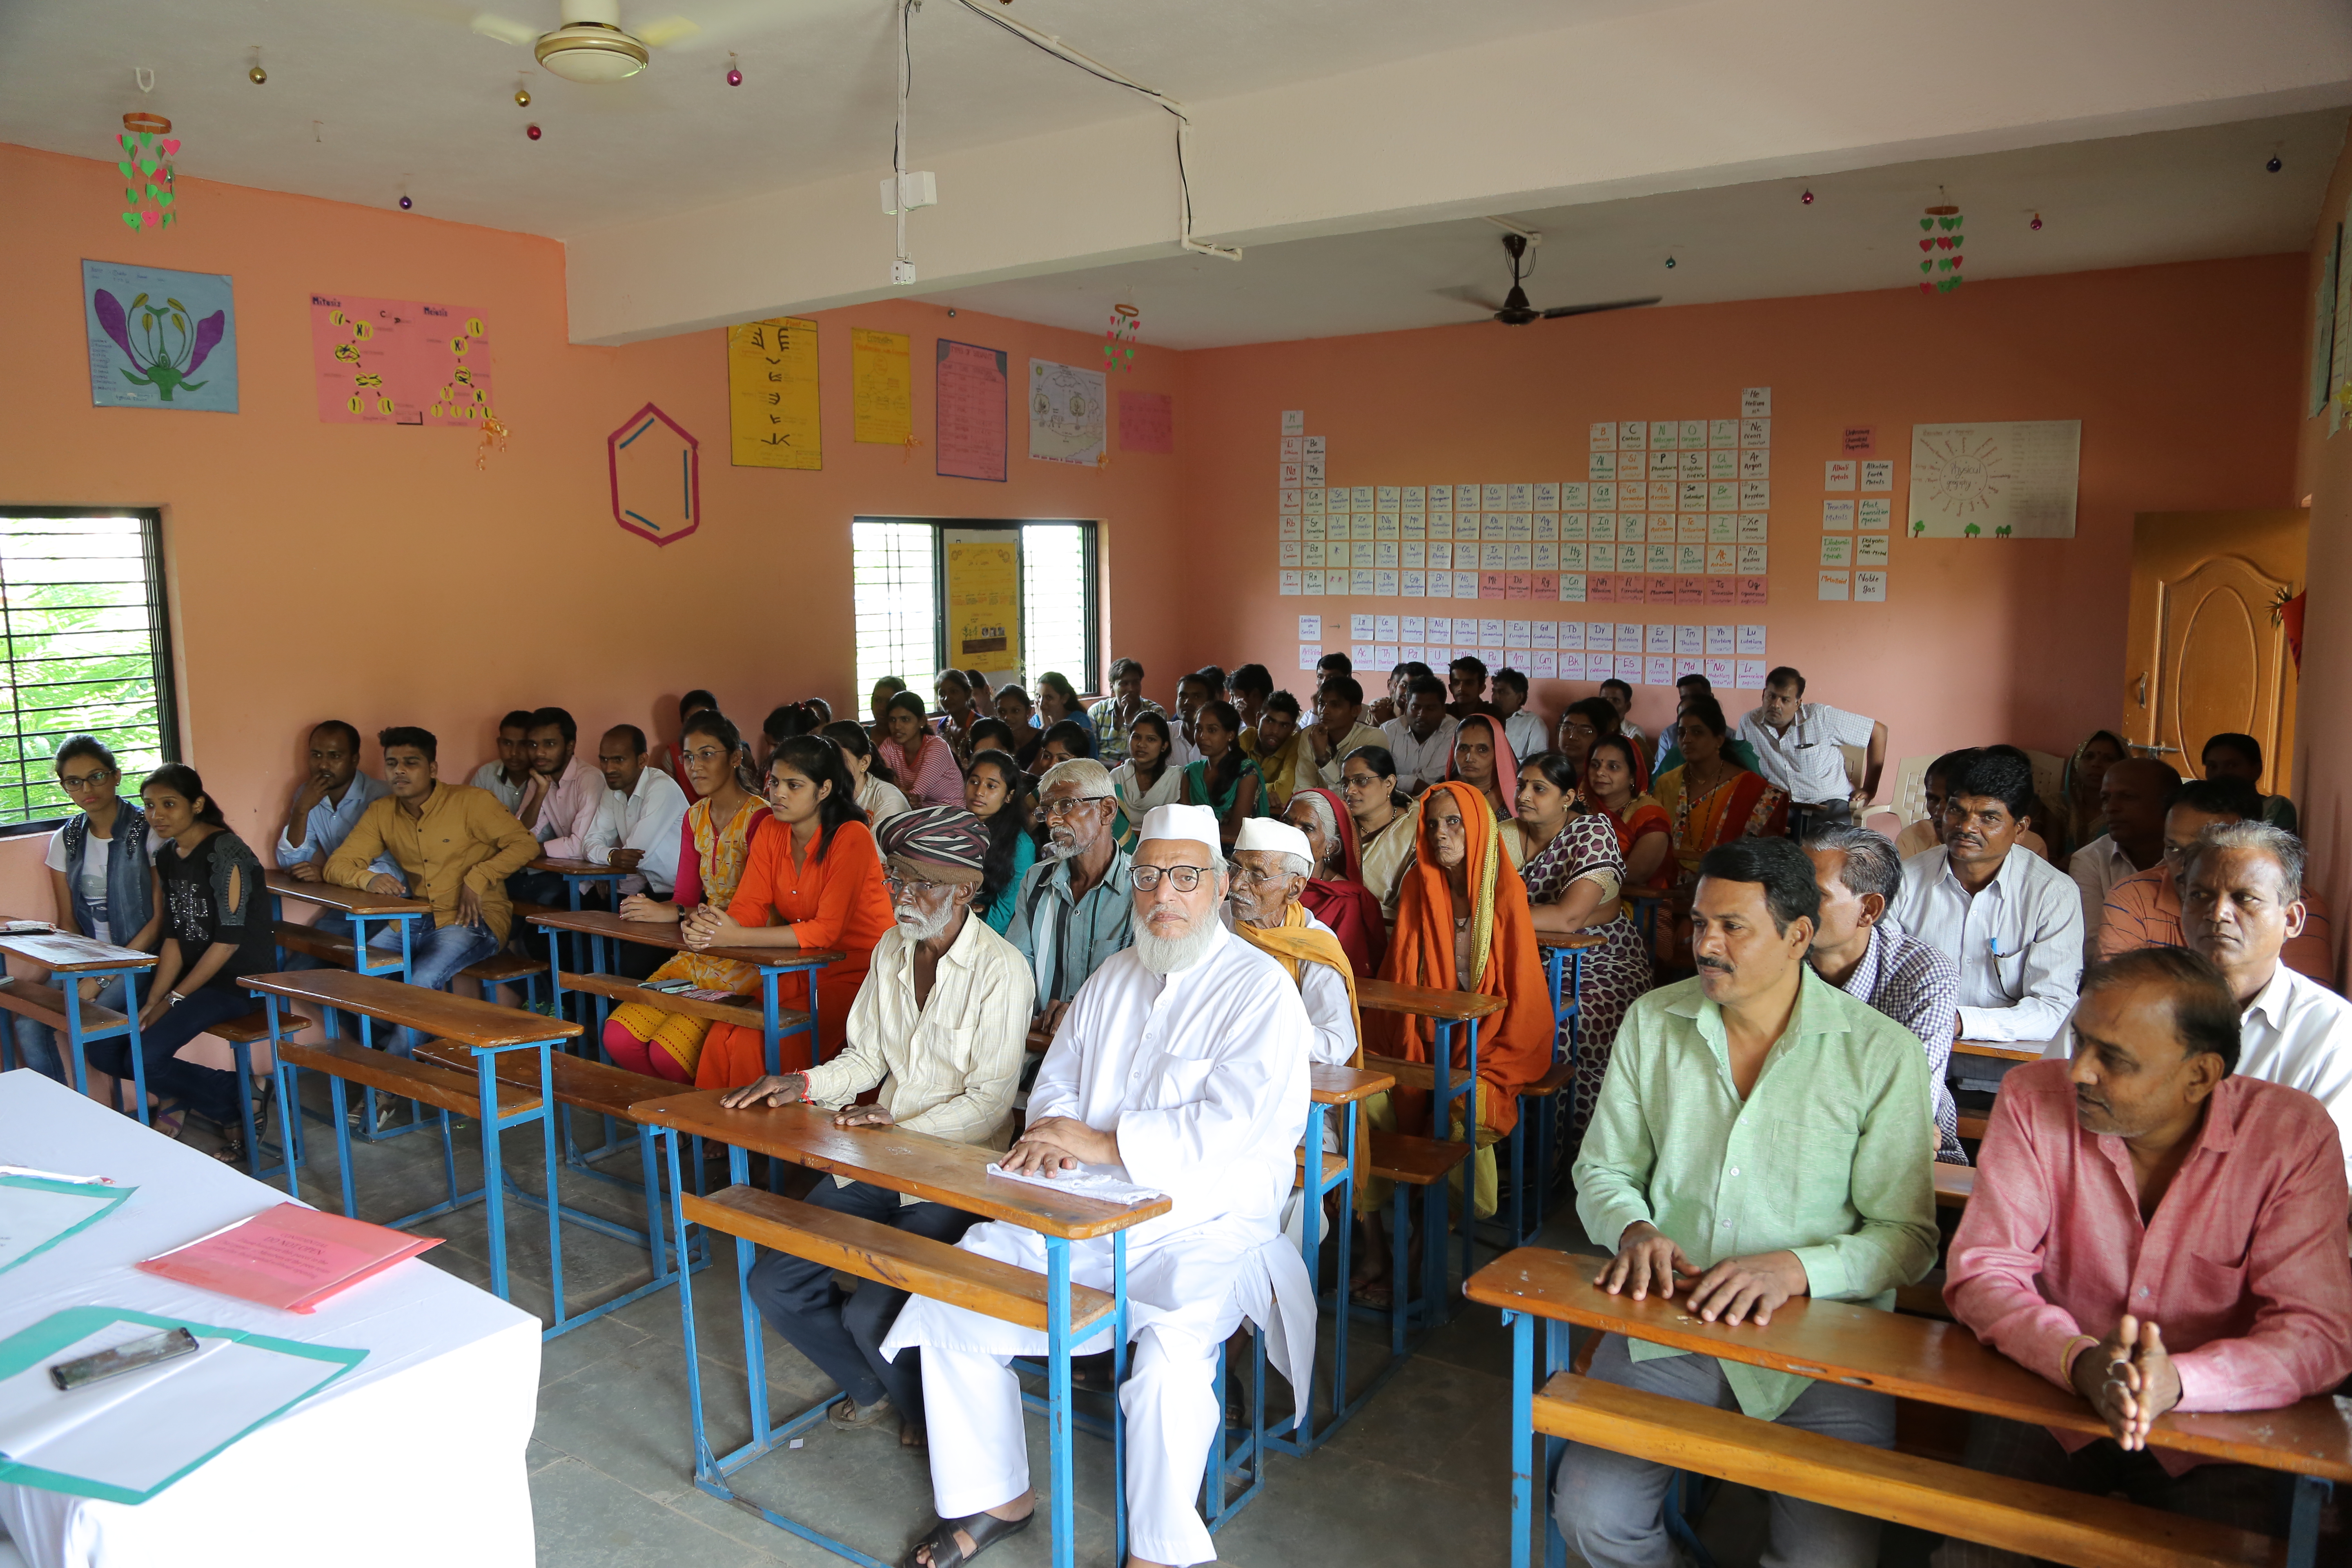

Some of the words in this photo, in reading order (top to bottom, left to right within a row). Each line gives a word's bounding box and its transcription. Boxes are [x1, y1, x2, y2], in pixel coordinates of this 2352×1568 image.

[1629, 424, 1636, 434] C
[1659, 425, 1665, 435] N
[1688, 426, 1696, 434] O
[1661, 454, 1666, 463] P
[1287, 466, 1295, 475] Na
[1287, 493, 1292, 502] K
[1858, 573, 1879, 582] Noble
